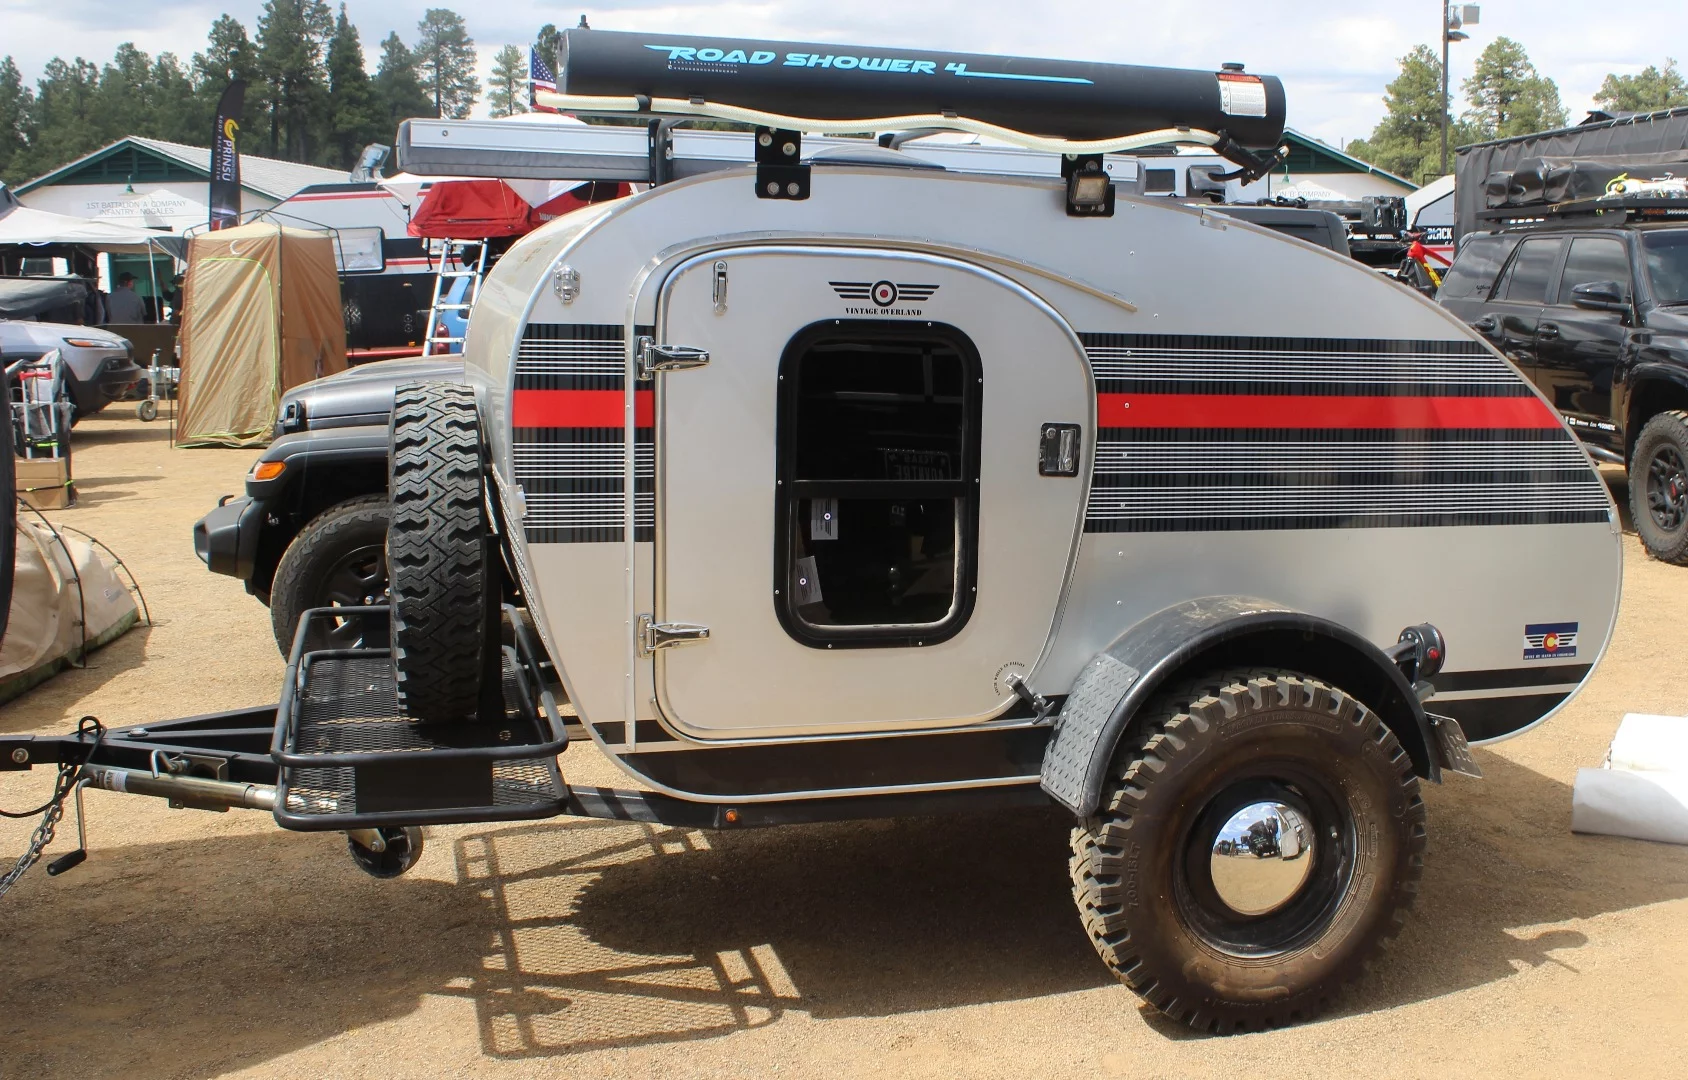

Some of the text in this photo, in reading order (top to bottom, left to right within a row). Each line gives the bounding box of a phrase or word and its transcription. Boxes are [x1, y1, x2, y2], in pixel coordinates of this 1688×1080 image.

[667, 46, 777, 65] ROAD
[782, 52, 937, 75] SHOWER
[221, 139, 232, 182] PRINSU
[86, 202, 99, 210] 1ST
[101, 201, 140, 209] BATTALION
[150, 200, 187, 208] COMPANY
[139, 207, 175, 215] NOGALES
[845, 307, 922, 316] VINTAGE OVERLAND
